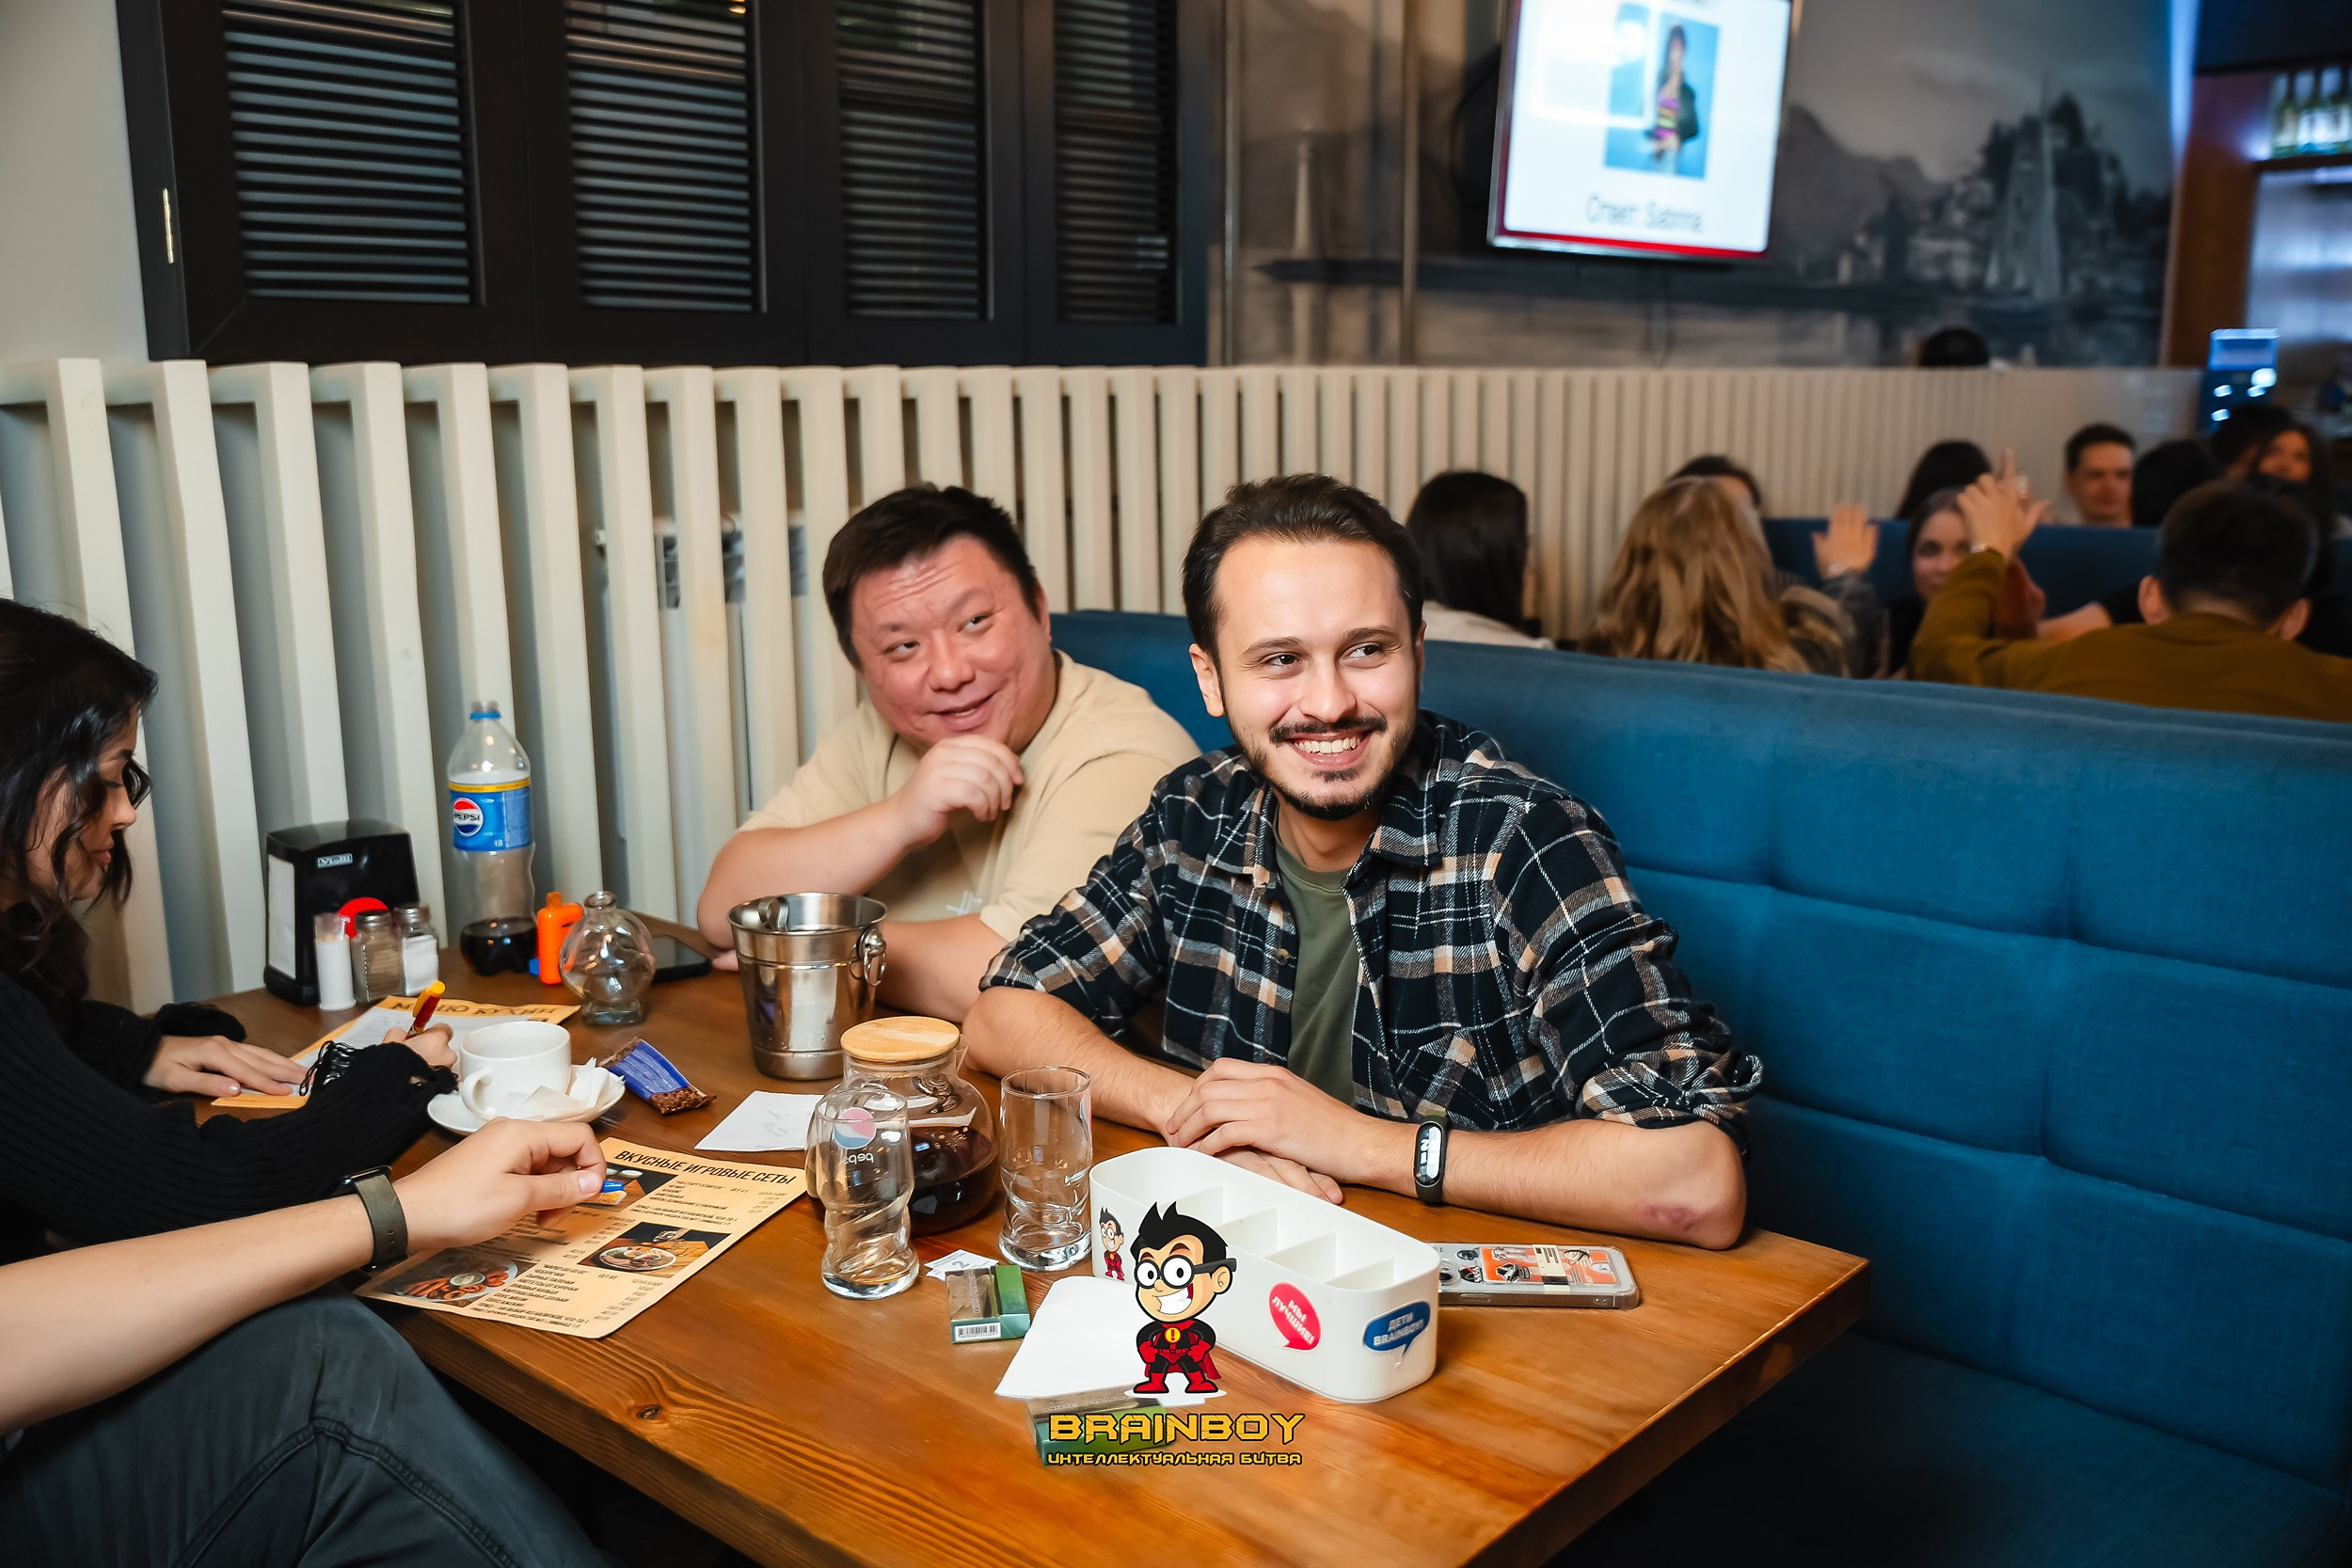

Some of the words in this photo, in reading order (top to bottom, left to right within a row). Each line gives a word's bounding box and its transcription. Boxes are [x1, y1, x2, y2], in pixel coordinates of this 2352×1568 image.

[614, 1150, 685, 1171] ВКУСНЫЕ
[683, 1164, 753, 1180] ИГРОВЫЕ
[755, 1172, 797, 1185] СЕТЫ
[1272, 1296, 1314, 1345] ЛУЧШИЕ!
[1289, 1300, 1307, 1323] МЫ
[1388, 1312, 1414, 1332] ДЕТИ
[1373, 1319, 1424, 1346] BRAINBOY!
